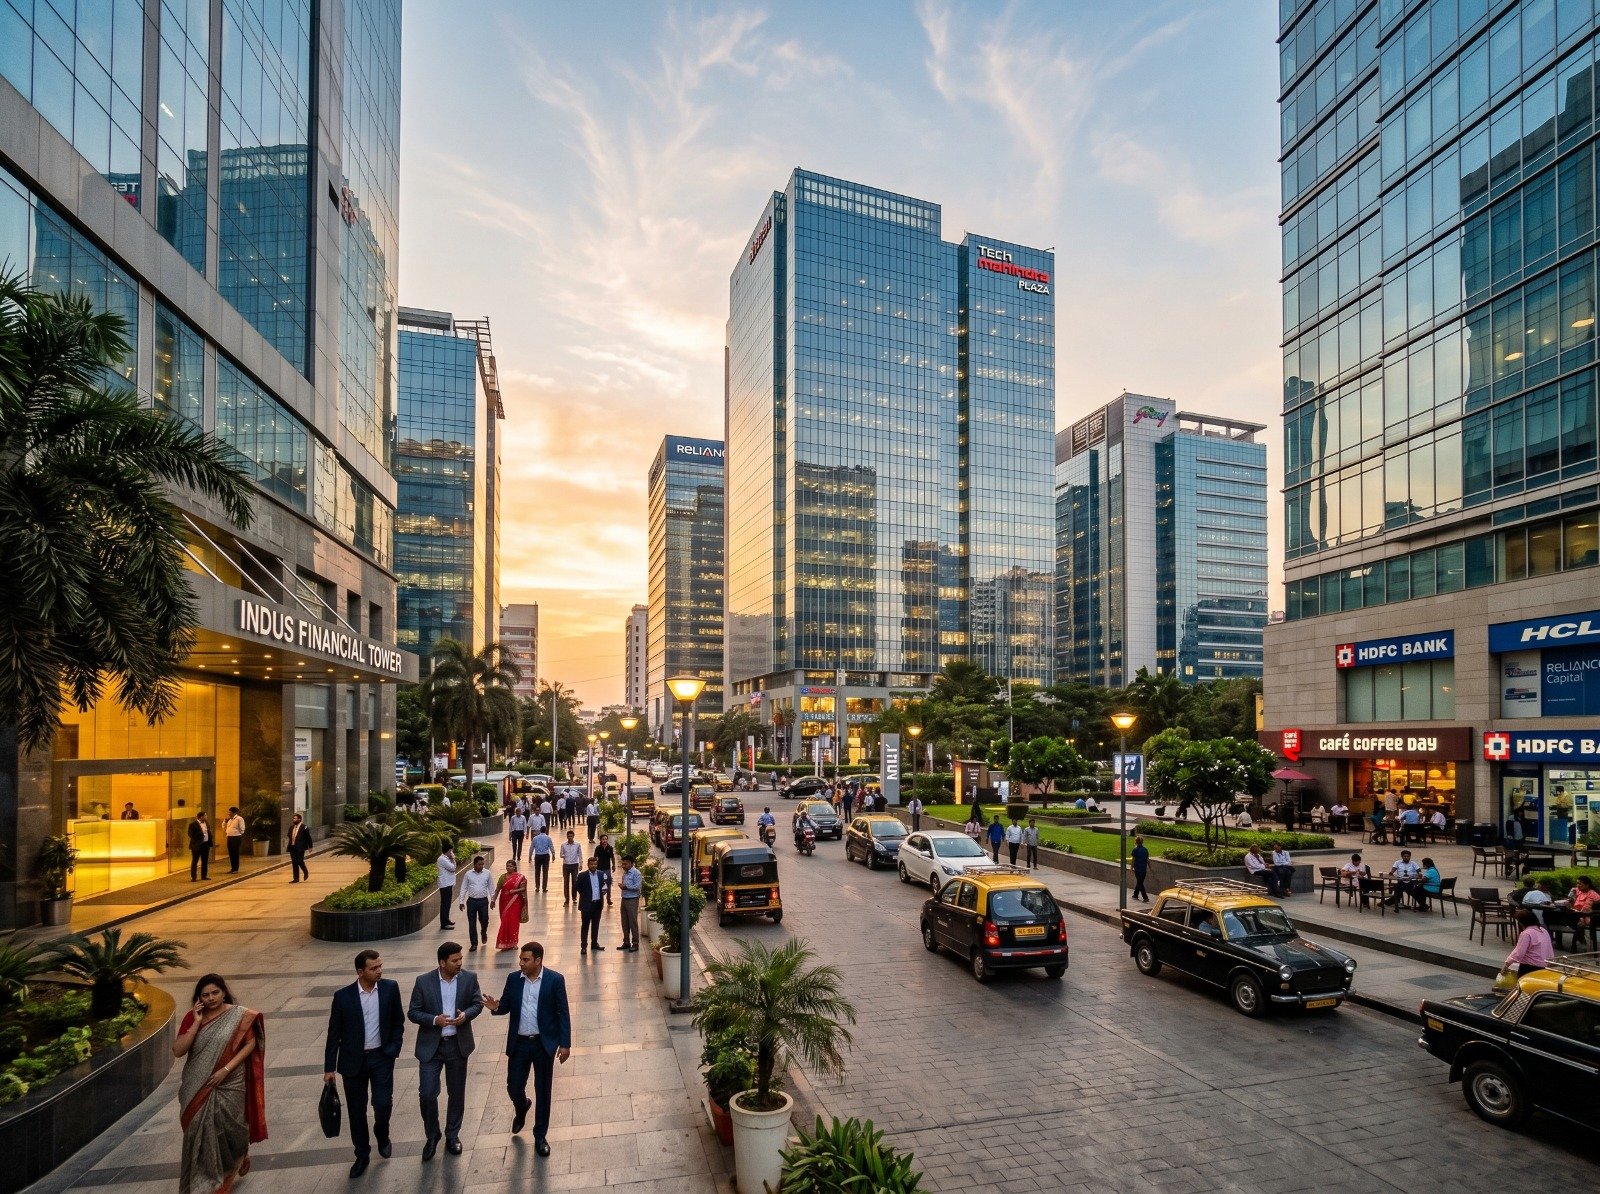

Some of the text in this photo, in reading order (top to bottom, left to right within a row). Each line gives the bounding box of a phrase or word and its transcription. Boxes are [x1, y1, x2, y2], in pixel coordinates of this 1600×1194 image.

[1018, 280, 1050, 295] PLAZA
[240, 600, 402, 674] INDUS FINANCIAL TOWER
[1521, 620, 1600, 642] HCL
[1358, 638, 1448, 660] HDFC BANK
[1546, 672, 1584, 685] Capital
[1516, 739, 1574, 754] HDFC
